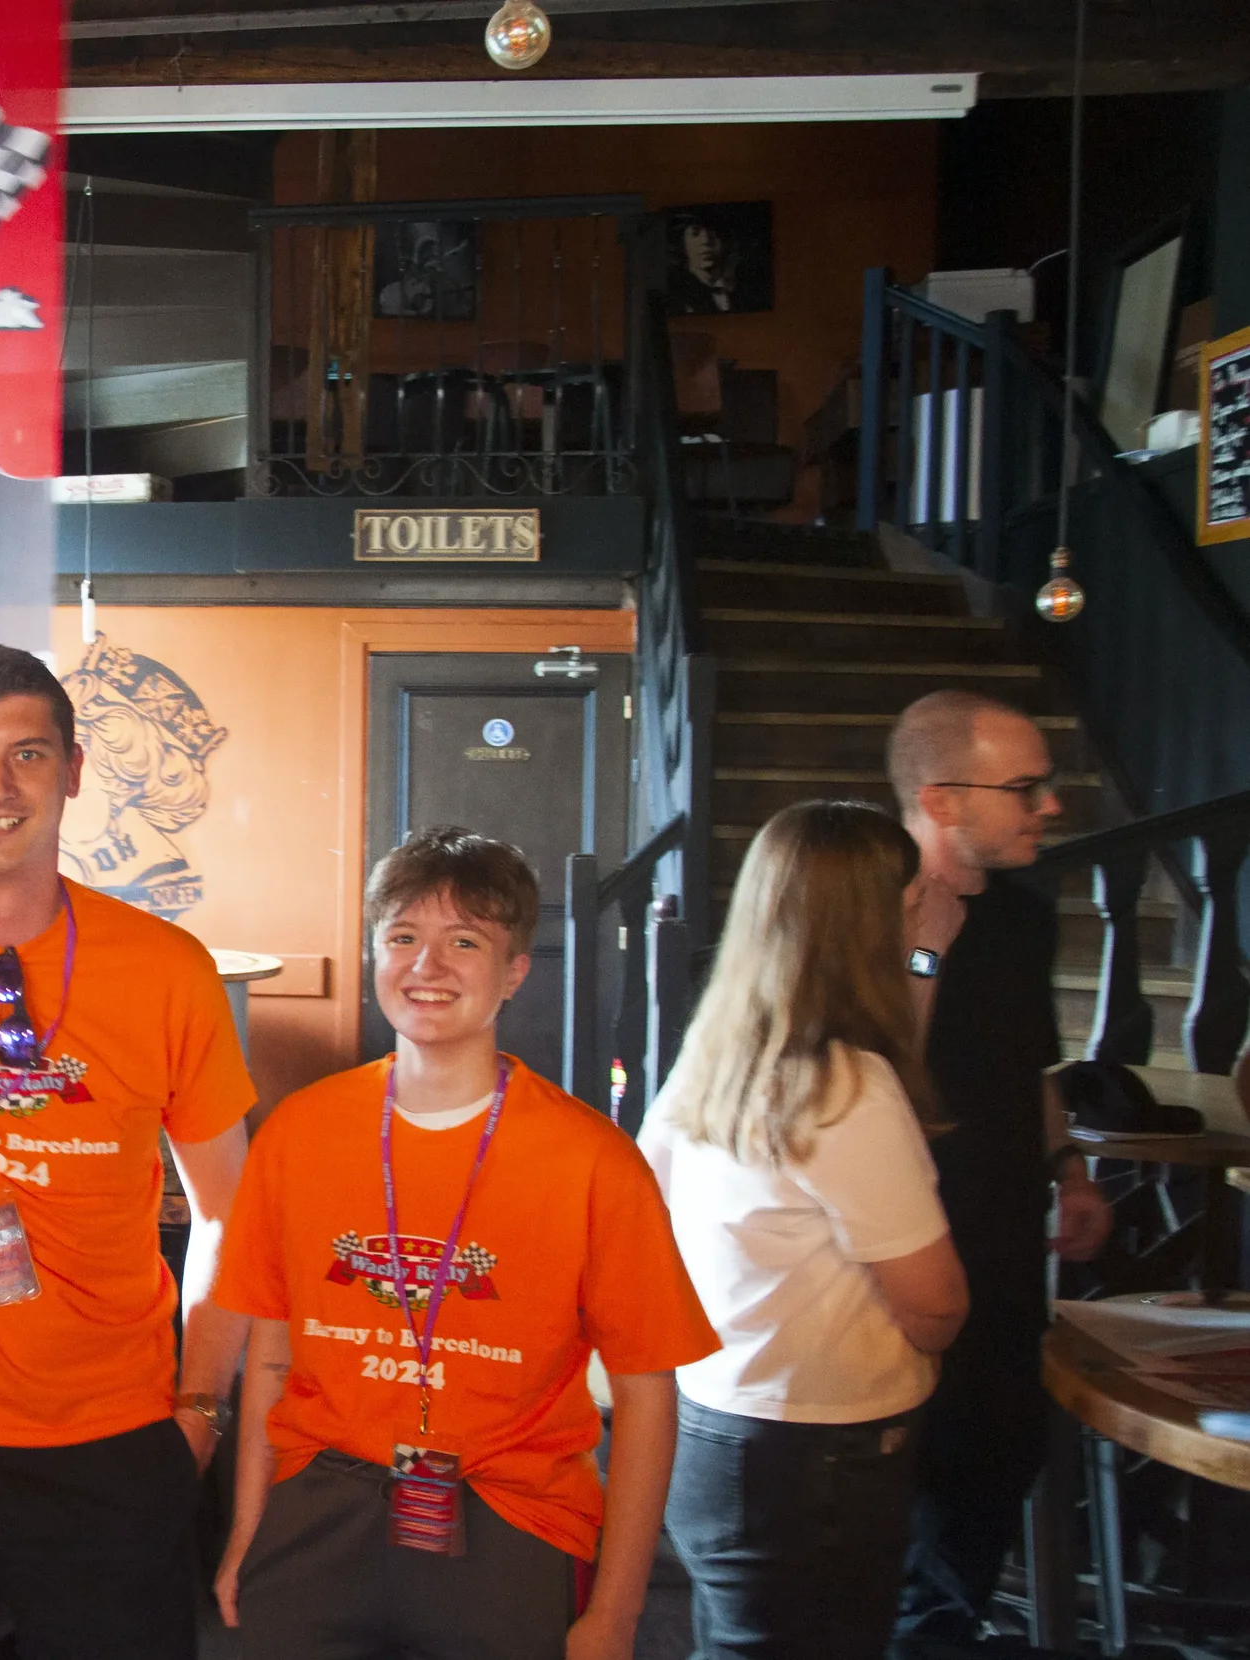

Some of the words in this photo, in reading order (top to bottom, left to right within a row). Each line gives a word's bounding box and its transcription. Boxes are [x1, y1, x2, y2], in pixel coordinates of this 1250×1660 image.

[363, 515, 535, 552] TOILETS
[6, 1133, 120, 1155] Barcelona
[415, 1264, 469, 1283] Raly
[375, 1327, 394, 1345] to
[399, 1328, 523, 1364] Brcelona
[360, 1354, 445, 1391] 2024
